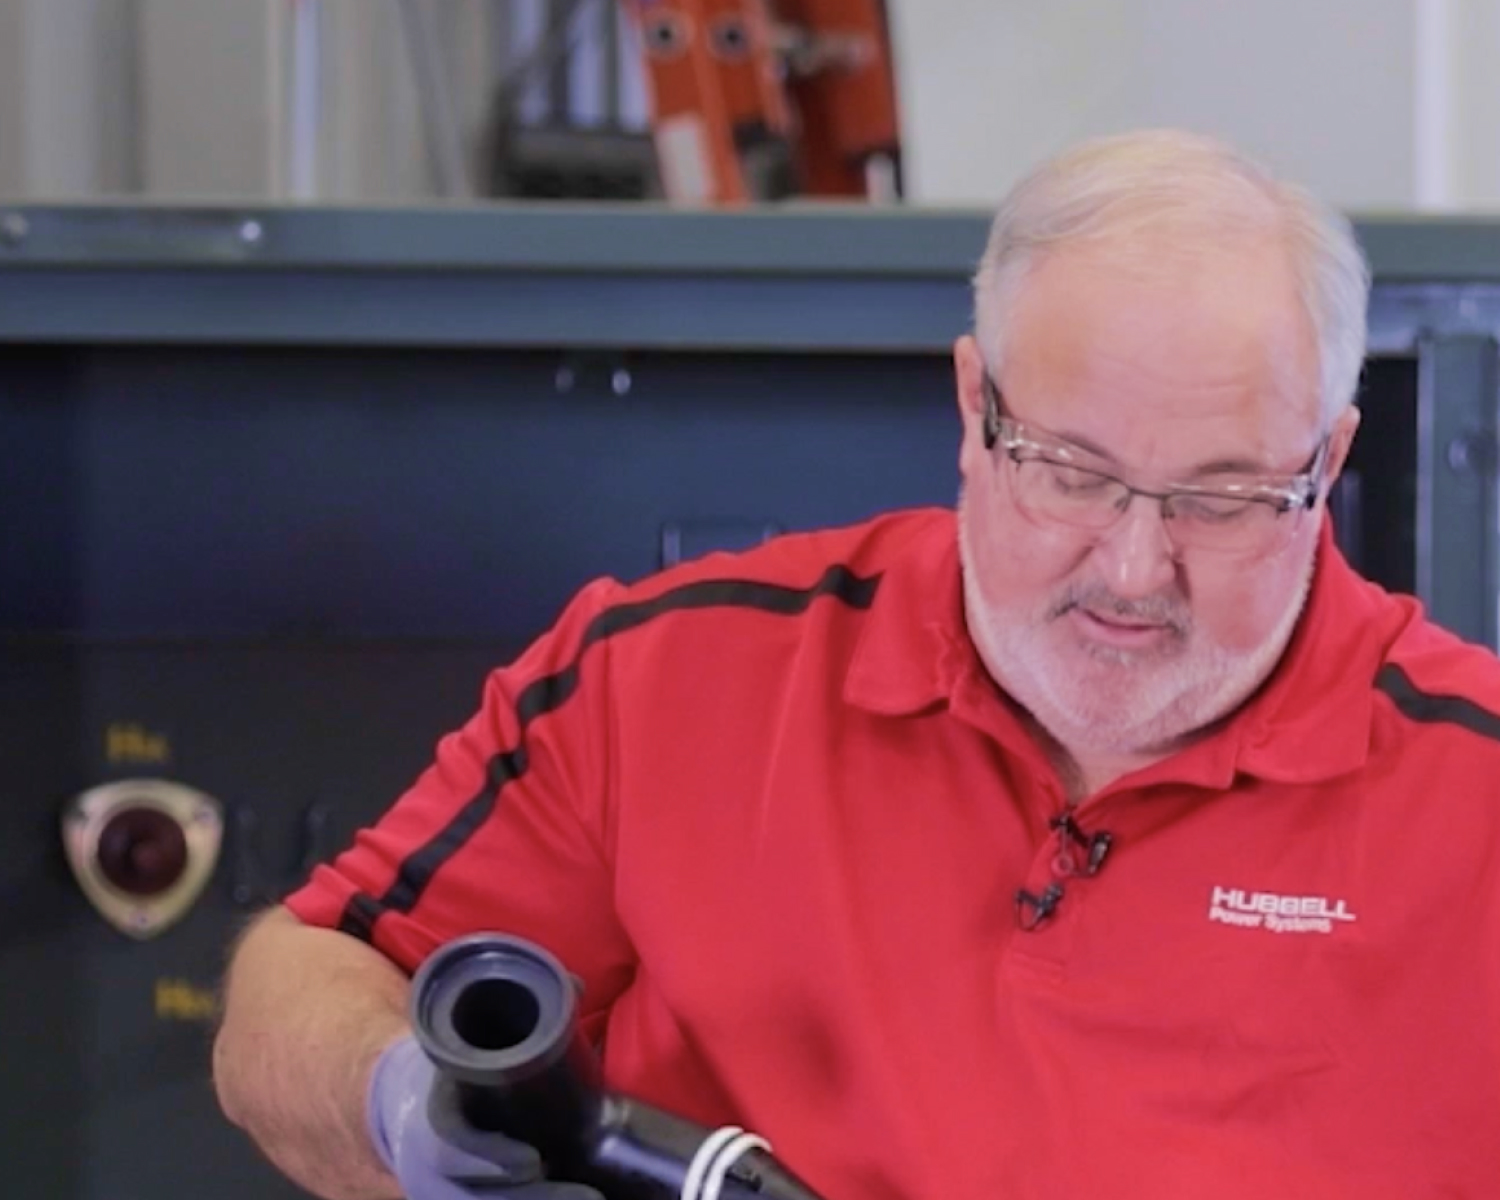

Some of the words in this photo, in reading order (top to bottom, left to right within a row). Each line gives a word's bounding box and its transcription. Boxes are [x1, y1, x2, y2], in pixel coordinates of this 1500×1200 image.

[1211, 886, 1356, 921] HUBBELL
[1209, 906, 1263, 927] Power
[1264, 913, 1333, 933] Systems
